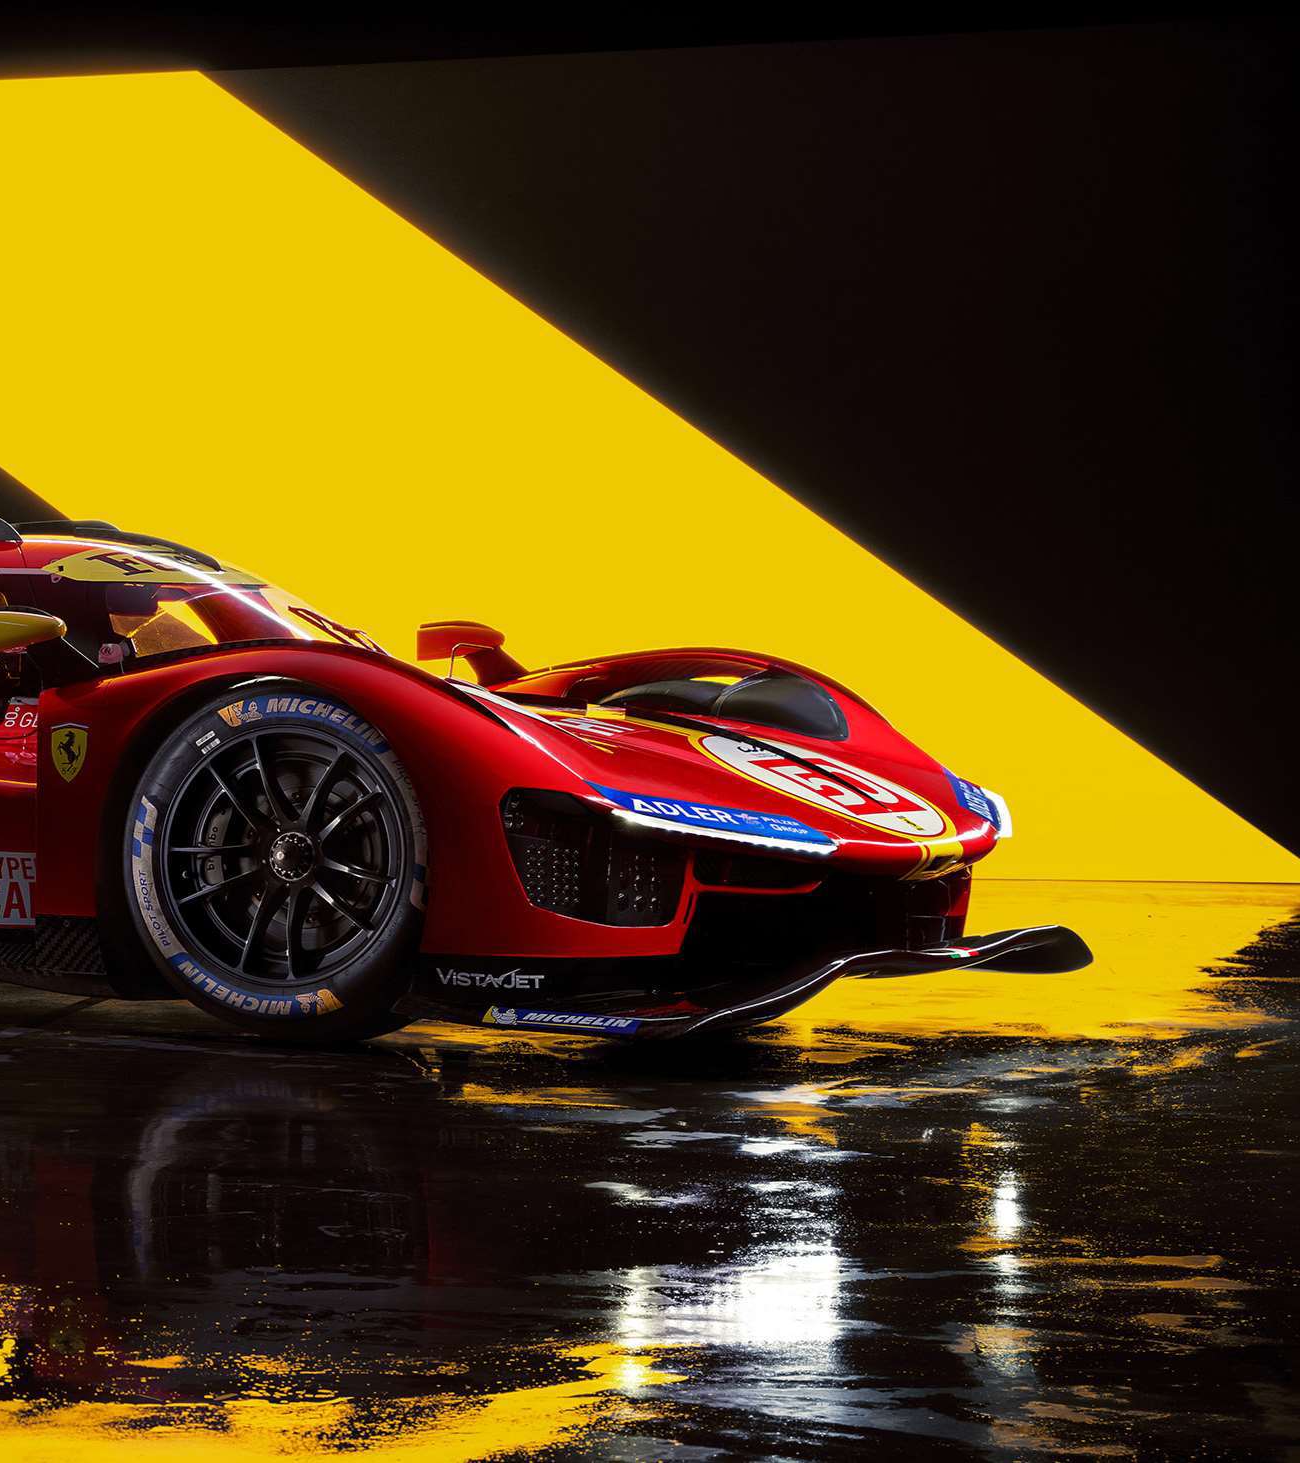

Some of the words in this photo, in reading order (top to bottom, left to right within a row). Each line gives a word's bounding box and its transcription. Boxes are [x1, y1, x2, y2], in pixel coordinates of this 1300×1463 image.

[267, 697, 386, 746] MICHELIN
[631, 798, 740, 825] ADLER
[138, 870, 154, 912] SPORT
[149, 915, 171, 947] PILOT
[177, 959, 293, 1016] MICHELIN
[522, 1012, 634, 1029] MICHELIN
